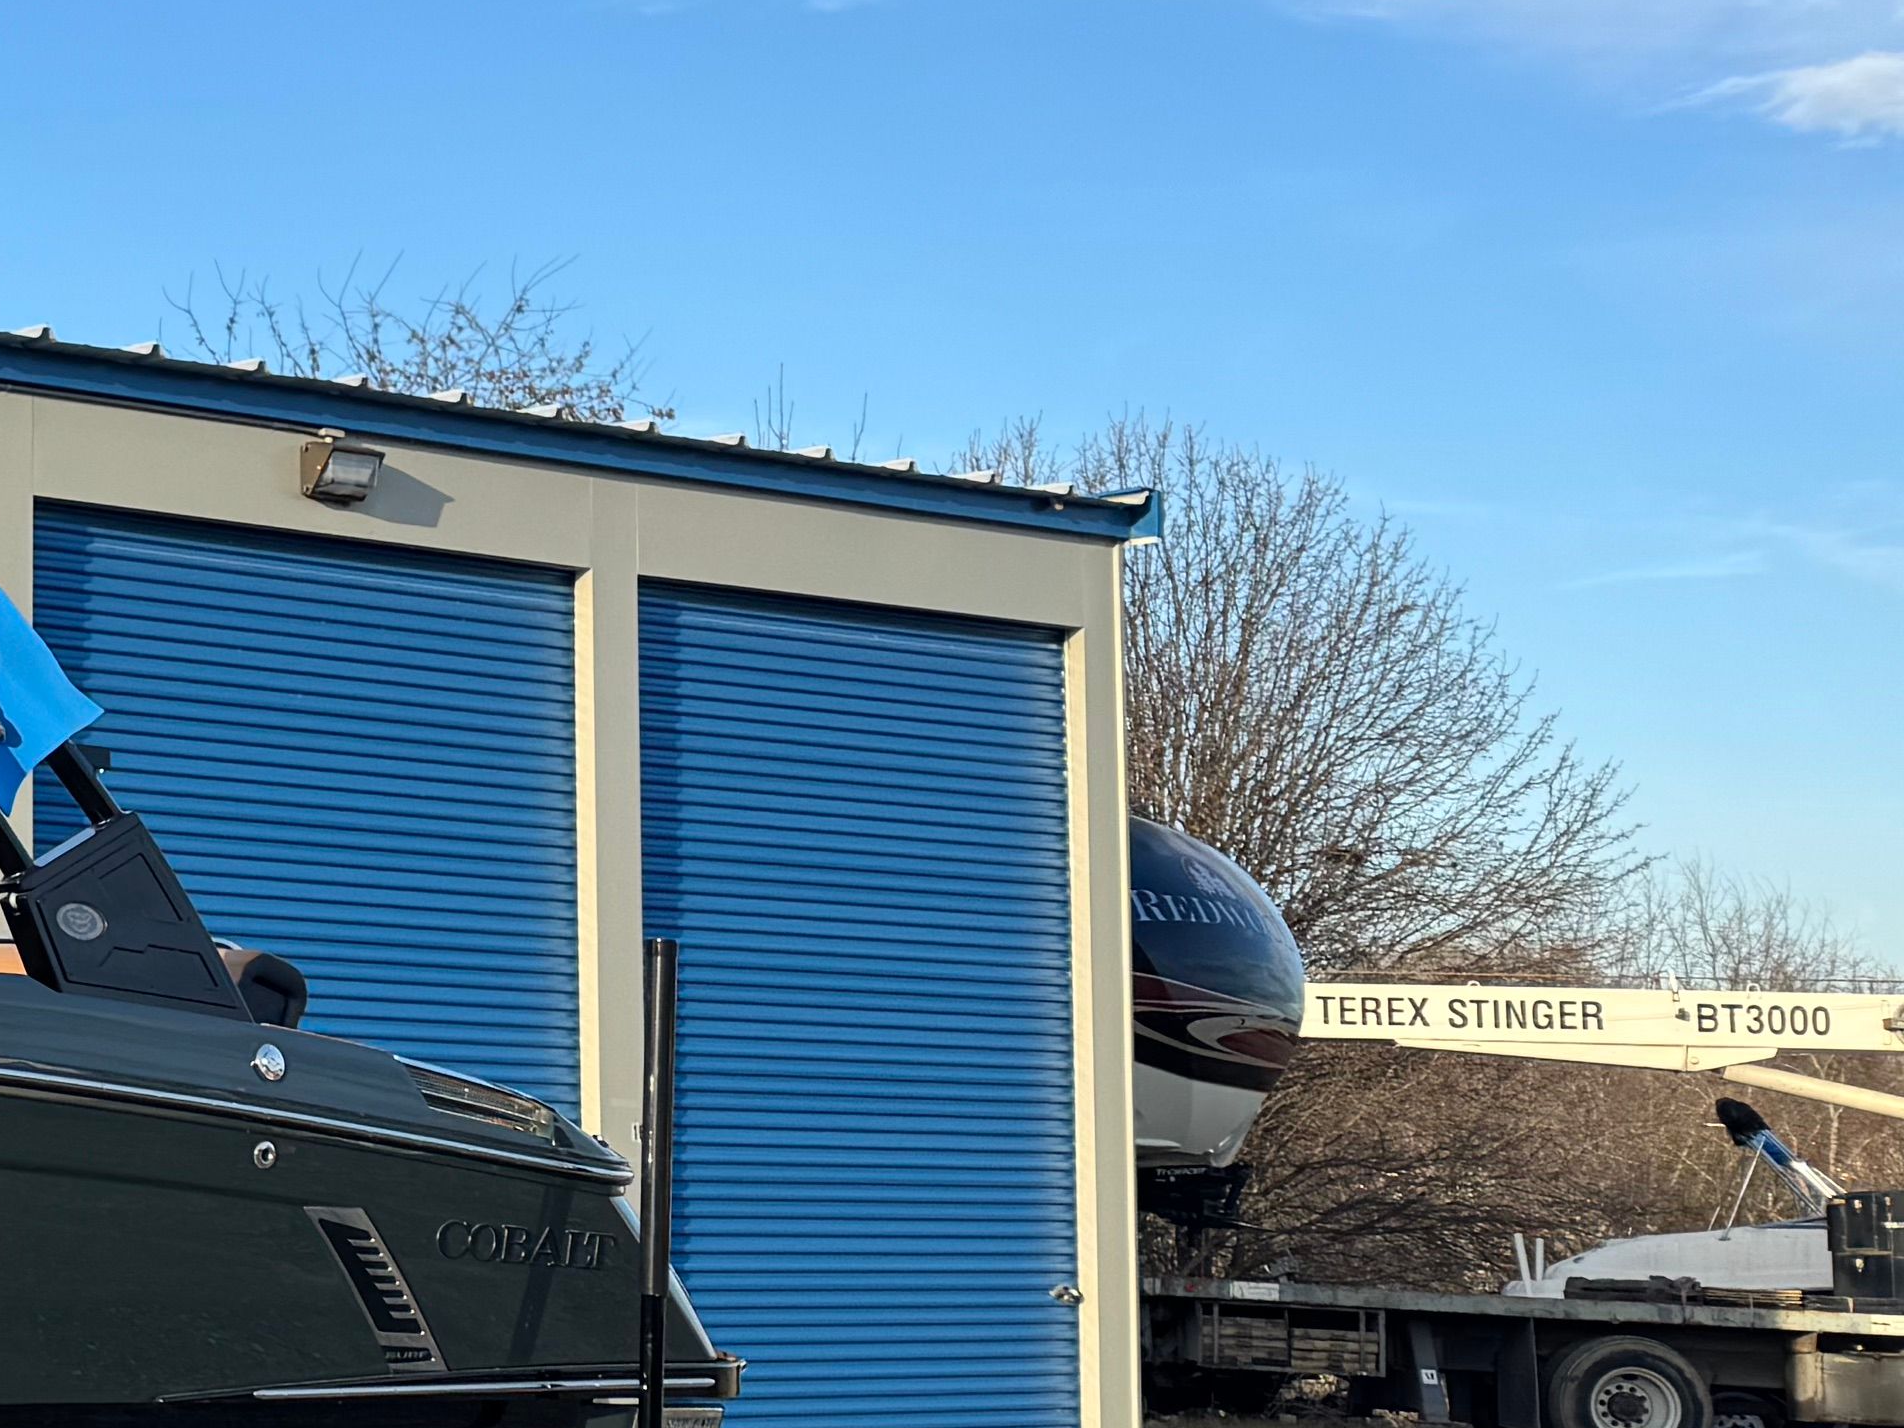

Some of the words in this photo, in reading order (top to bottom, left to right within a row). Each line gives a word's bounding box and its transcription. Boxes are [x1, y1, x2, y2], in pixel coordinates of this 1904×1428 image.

[1315, 995, 1431, 1027] TEREX
[1448, 998, 1604, 1030] STINGER
[1697, 1003, 1831, 1036] BT3000
[436, 1219, 616, 1270] COBALT
